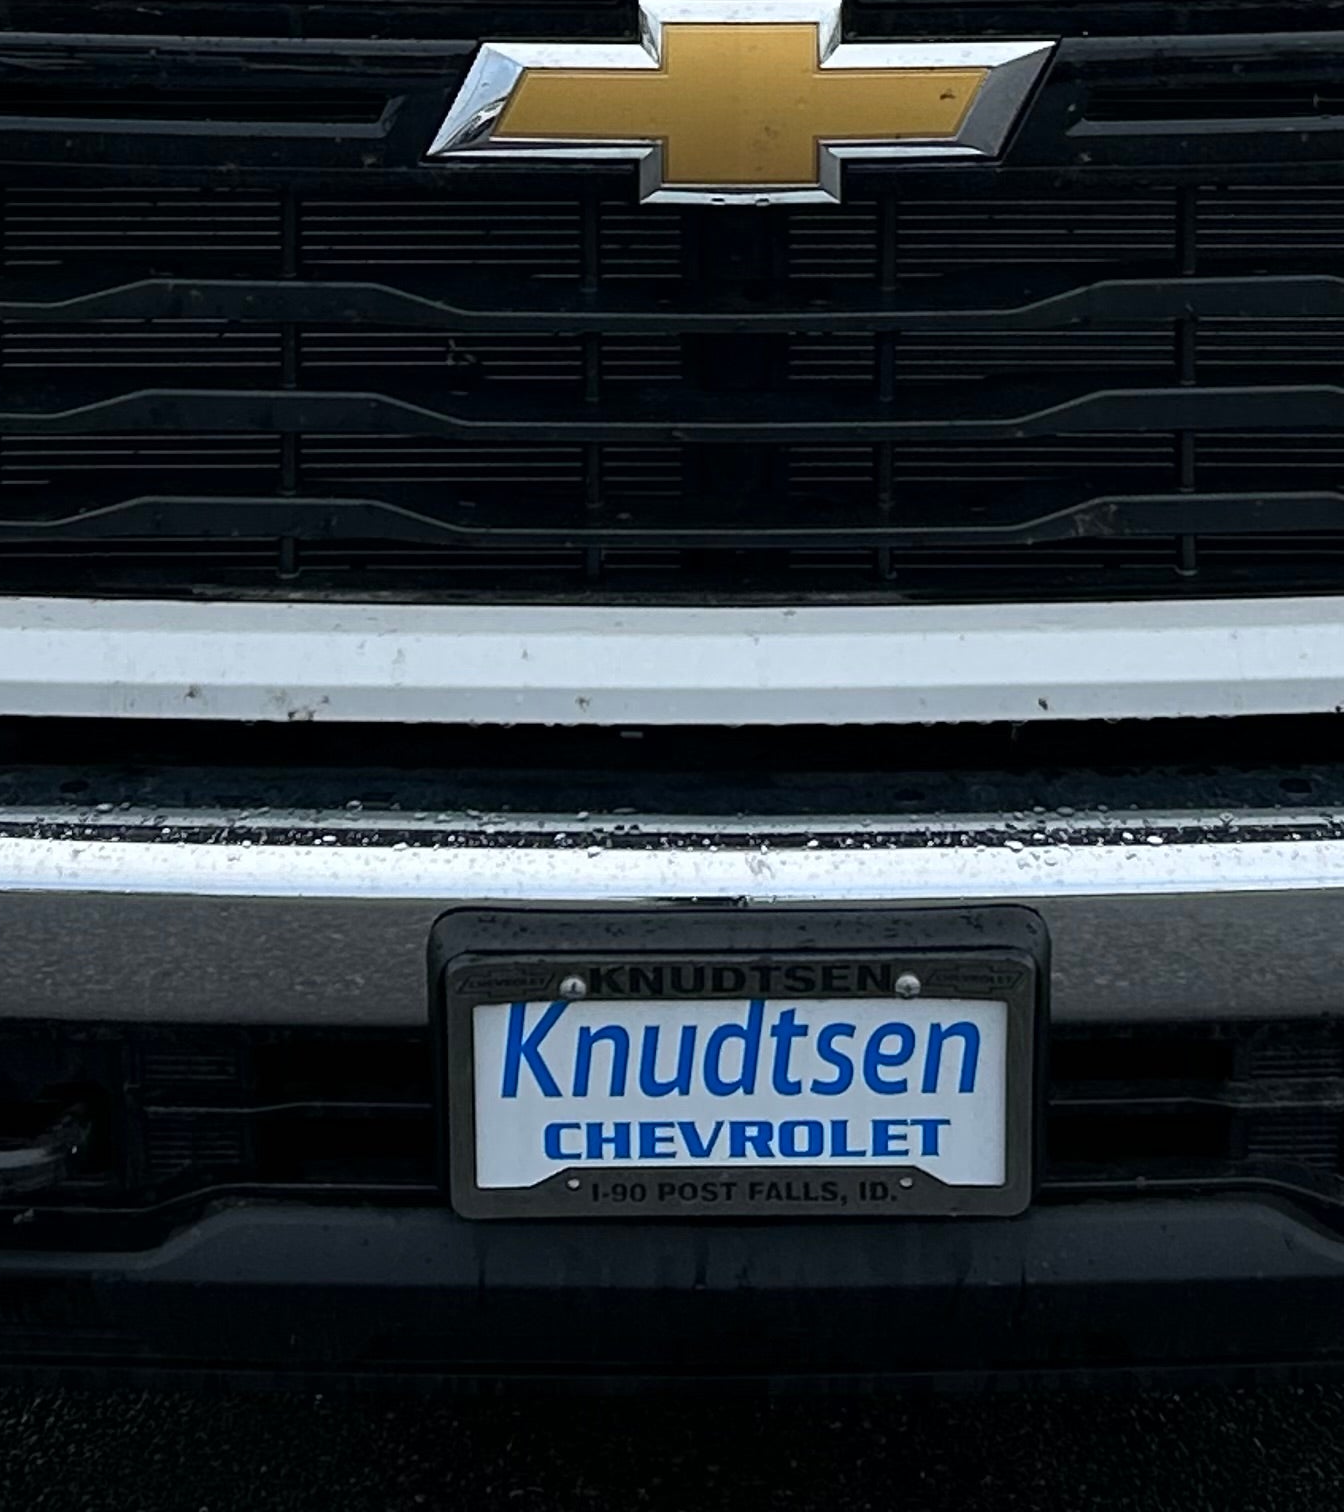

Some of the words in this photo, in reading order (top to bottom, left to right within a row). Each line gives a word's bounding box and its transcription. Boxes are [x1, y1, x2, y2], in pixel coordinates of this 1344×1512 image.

[589, 964, 892, 996] KNUDTSEN
[501, 999, 982, 1098] Knudtsen
[544, 1118, 951, 1161] CHEVROLET
[591, 1182, 647, 1203] I-90
[658, 1182, 737, 1202] POST
[748, 1181, 848, 1206] FALLS,
[859, 1181, 898, 1202] ID.
